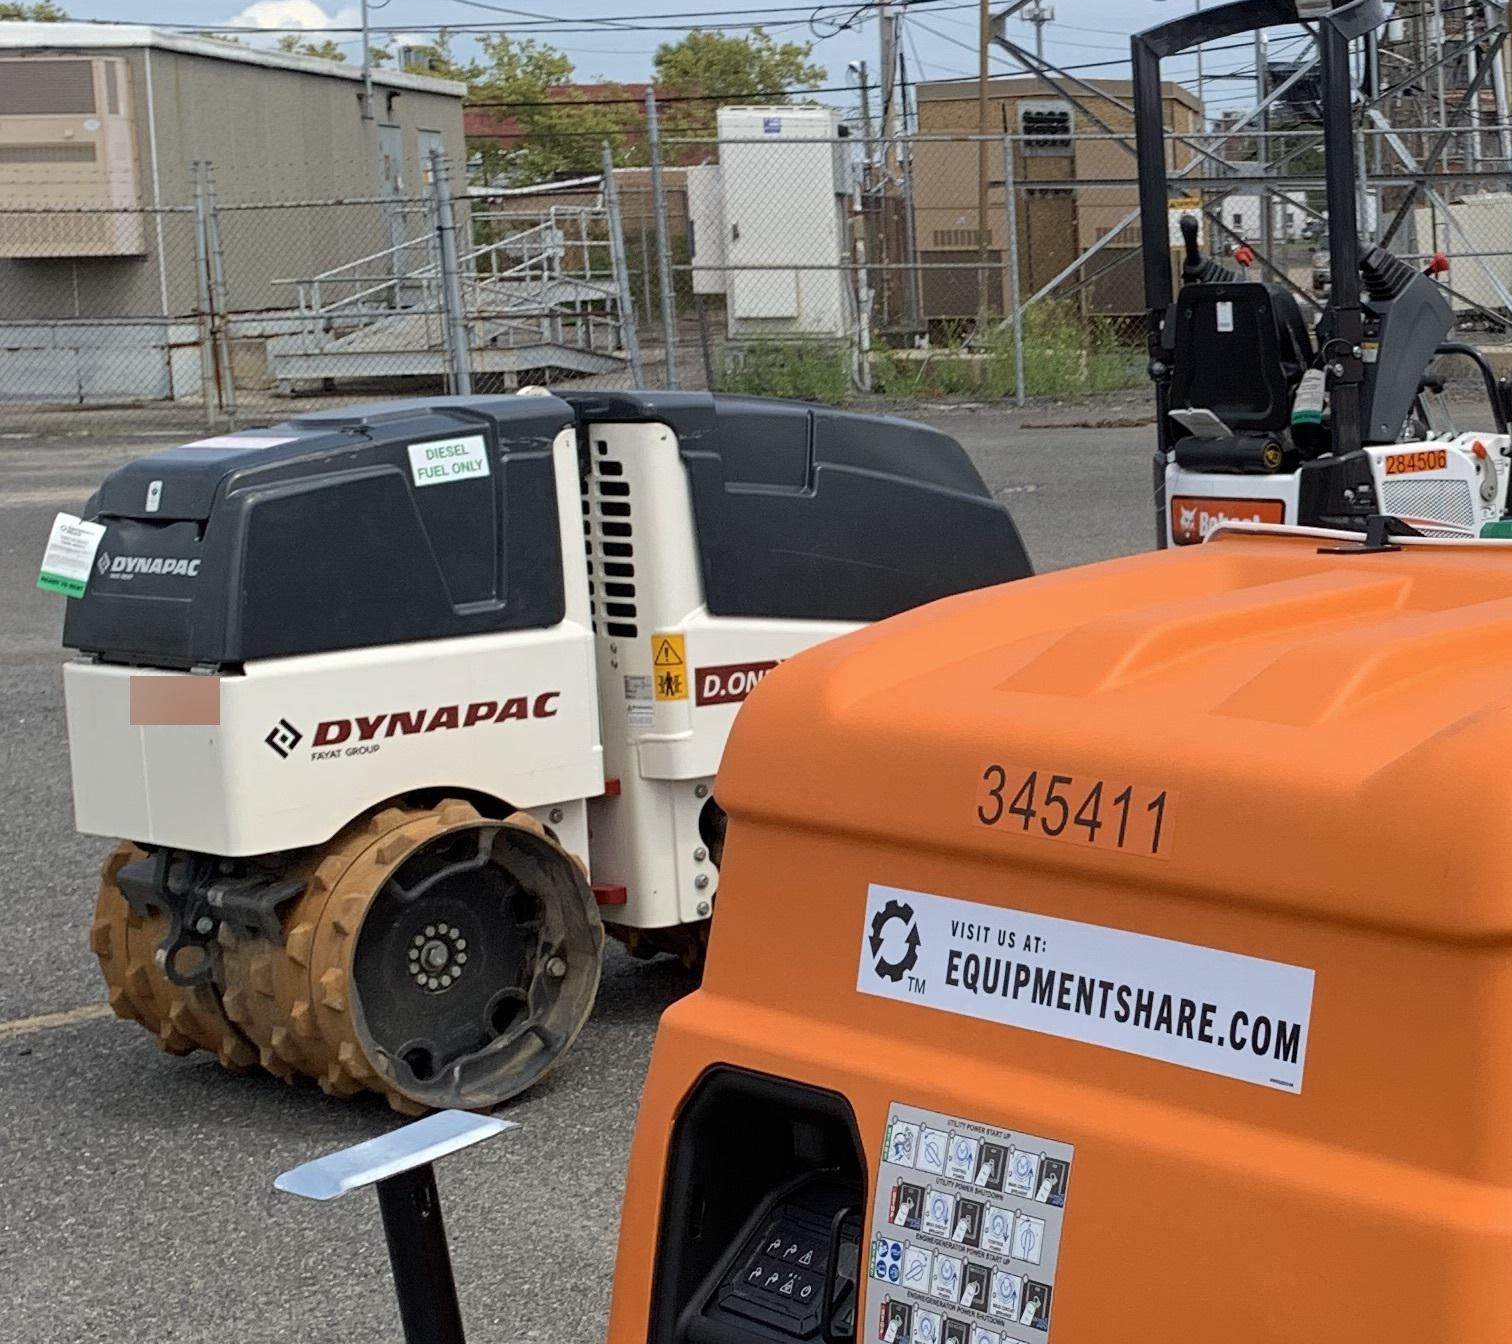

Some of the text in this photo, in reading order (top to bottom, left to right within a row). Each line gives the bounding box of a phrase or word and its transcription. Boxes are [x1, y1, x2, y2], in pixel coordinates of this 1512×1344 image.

[425, 444, 470, 460] DIESEL
[1386, 449, 1447, 476] 284506
[417, 459, 484, 480] FUEL ONLY
[109, 556, 202, 577] DYNAPAC
[703, 669, 773, 699] D.ON
[311, 691, 561, 748] DYNAPAC
[311, 744, 381, 762] FAYAT GROUP
[976, 763, 1168, 855] 345411
[950, 919, 1048, 954] VISIT US AT:
[907, 976, 927, 996] TM
[944, 949, 1302, 1065] EQUIPMENTSHARE.COM
